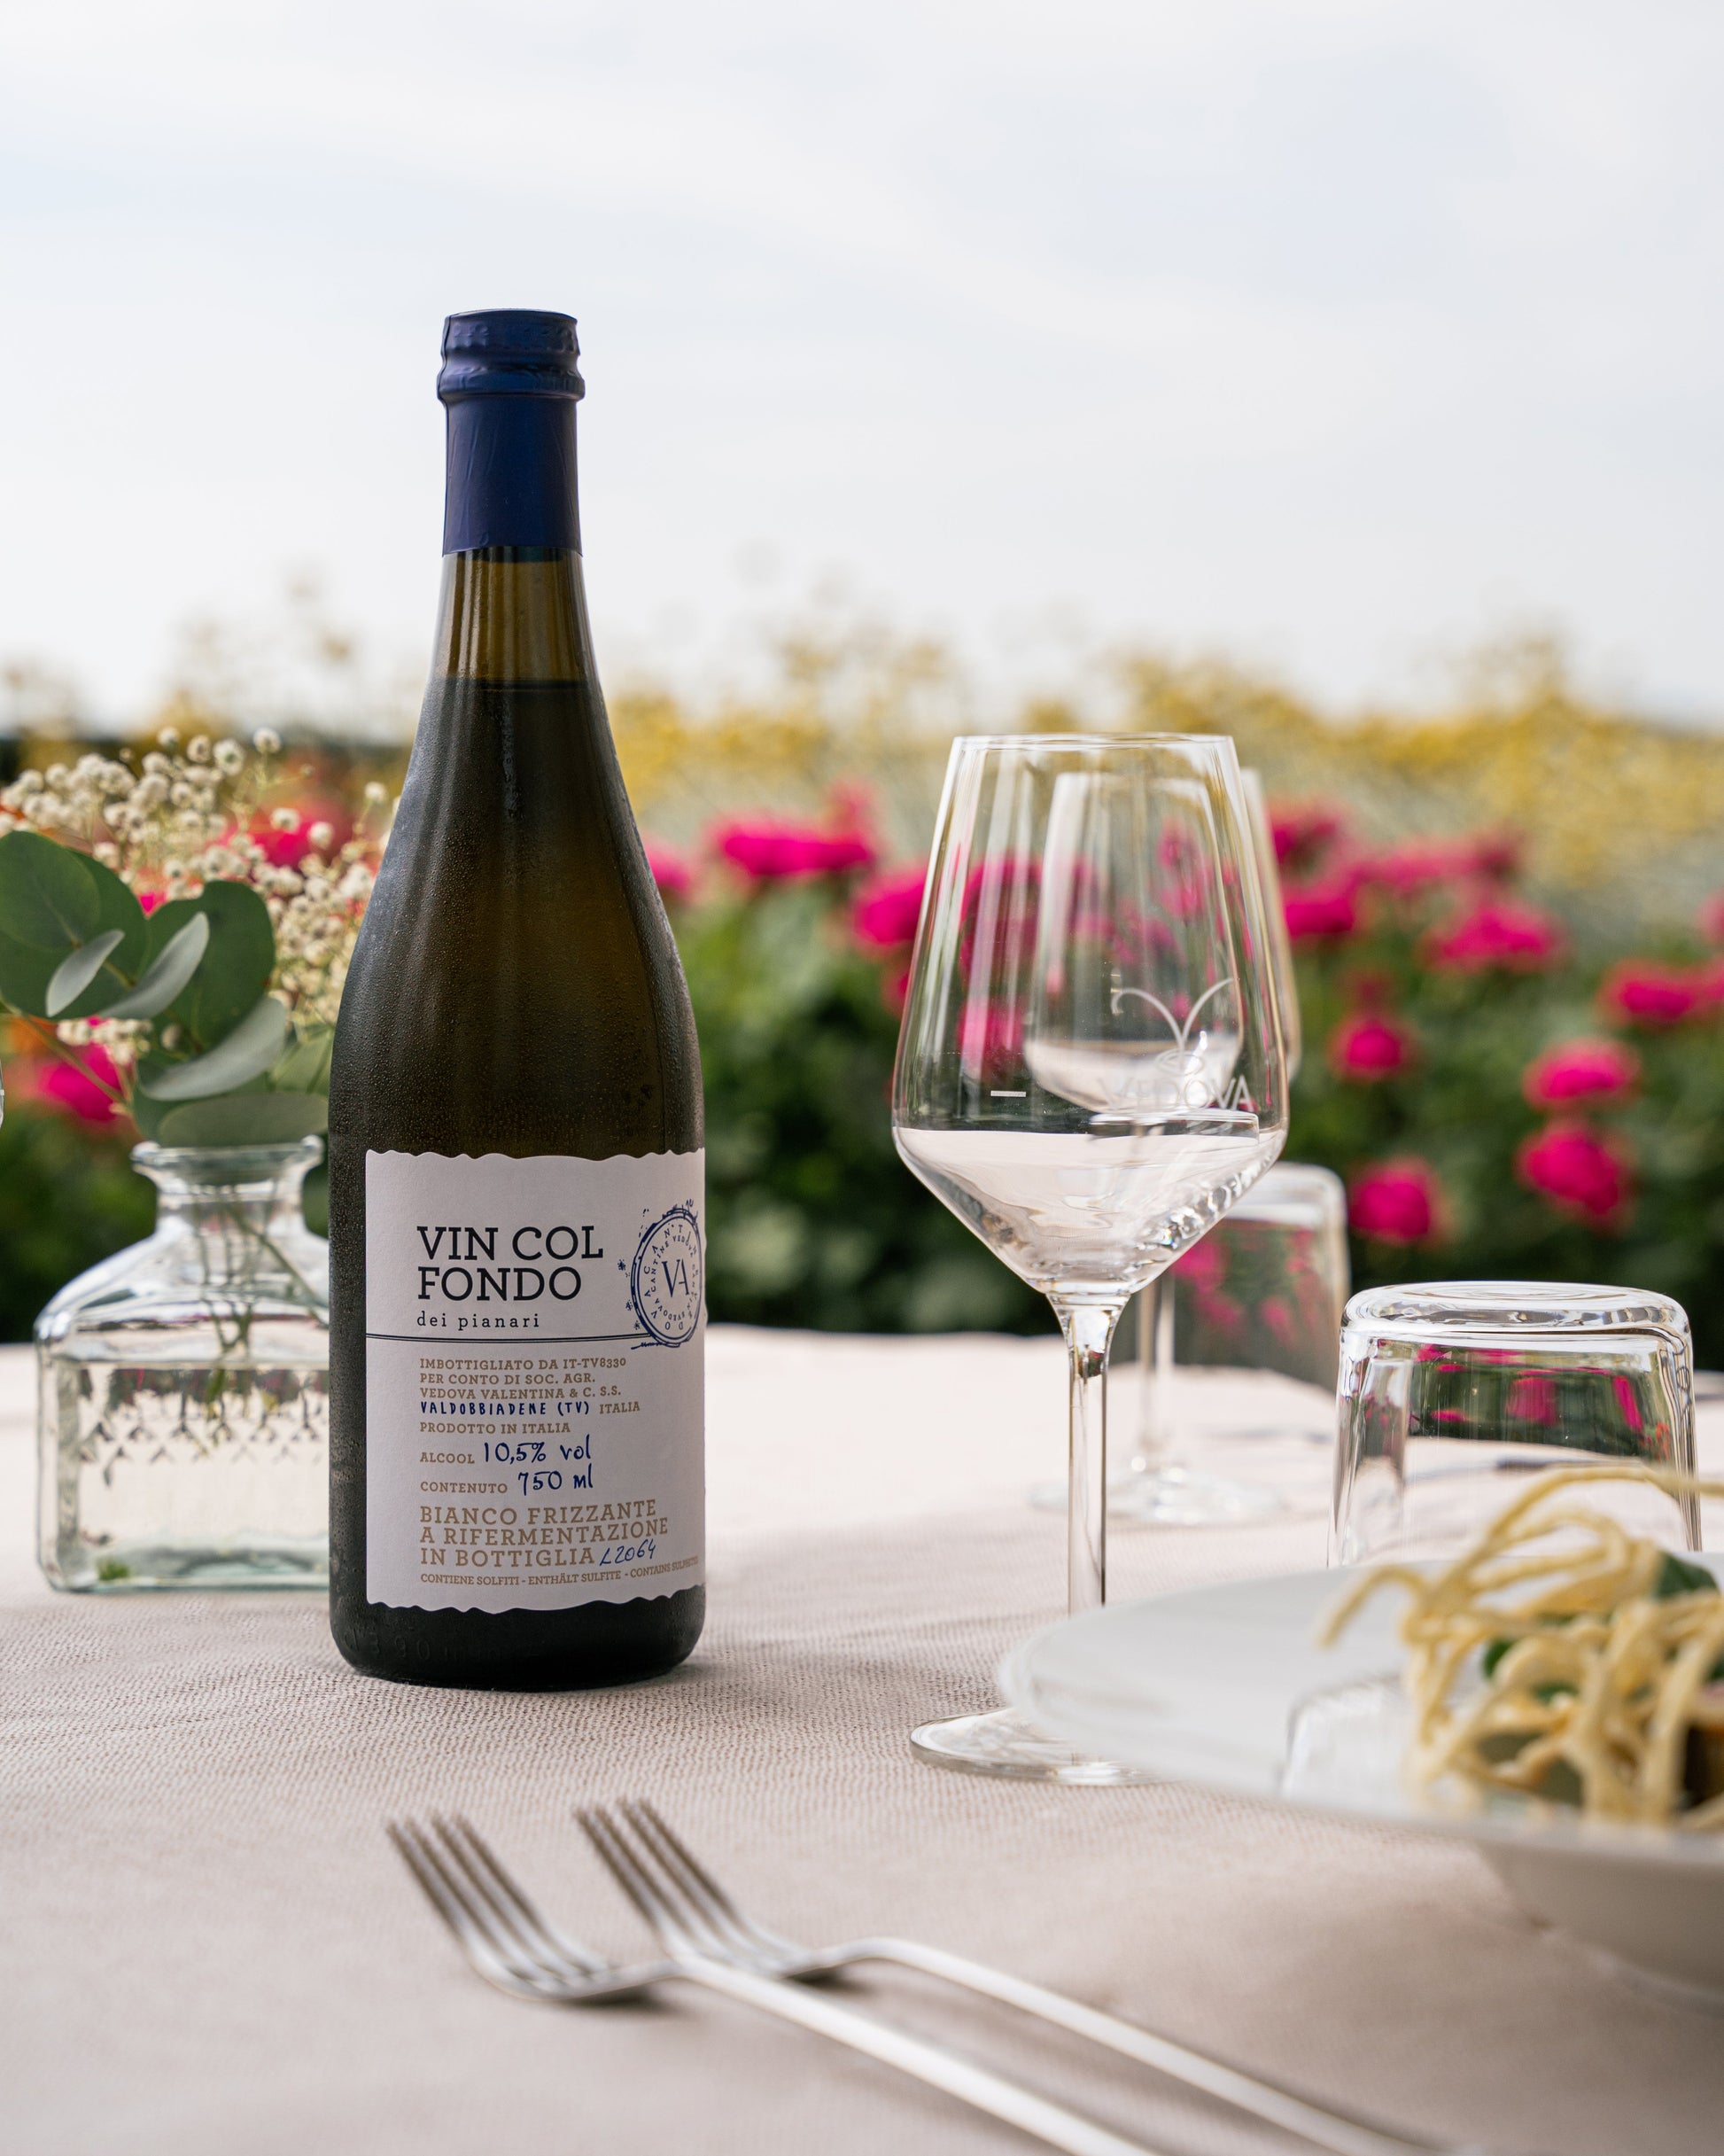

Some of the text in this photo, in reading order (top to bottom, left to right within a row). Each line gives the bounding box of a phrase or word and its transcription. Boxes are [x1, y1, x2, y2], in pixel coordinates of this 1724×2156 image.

[417, 1226, 602, 1260] VIN COL
[418, 1266, 581, 1301] FONDO
[662, 1258, 689, 1297] VA
[417, 1311, 539, 1331] dei pianari
[421, 1358, 625, 1370] IMBOTTIGLIATO DA IT-TV8330
[421, 1374, 594, 1384] PER CONTO DI SOC. AGR.
[420, 1386, 620, 1399] VEDOVA VALENTINA & C. S.S.
[421, 1401, 640, 1416] VALDOBBIADENE (TV) ITALIA
[421, 1422, 571, 1434] PRODOTTO IN ITALIA
[420, 1435, 590, 1464] ALCOOL 10,5% vol
[421, 1463, 593, 1496] CONTENUTO 750 ml
[421, 1499, 656, 1525] BIANCO FRIZZANTE
[420, 1517, 668, 1545] A RIFERMENTAZIONE
[422, 1538, 656, 1567] IN BOTTIGLIA L2064
[421, 1574, 474, 1584] CONTIENE
[477, 1576, 519, 1585] SOLFITI
[529, 1573, 579, 1584] ENTHÄLT
[581, 1570, 621, 1582] SULFITE
